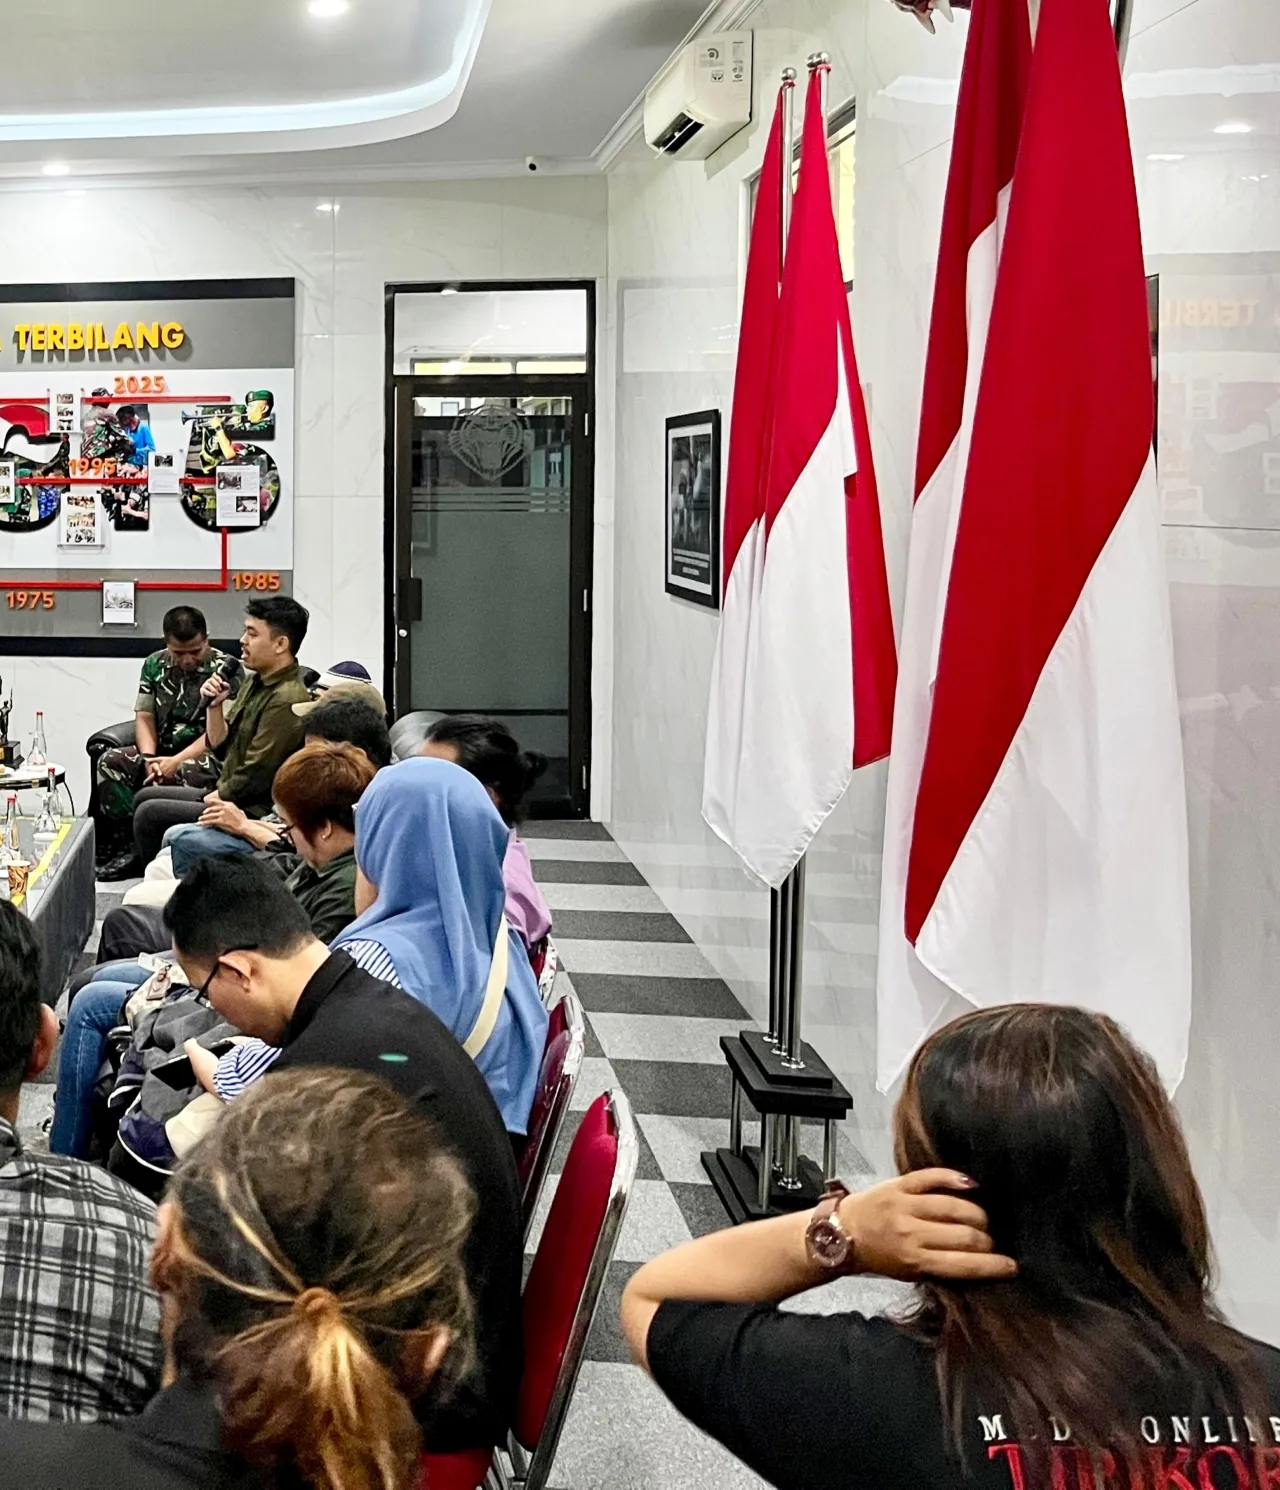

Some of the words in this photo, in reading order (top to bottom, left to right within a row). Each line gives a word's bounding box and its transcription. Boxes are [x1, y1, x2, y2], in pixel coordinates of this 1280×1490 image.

[15, 321, 185, 351] TERBILANG
[113, 375, 166, 395] 2025
[68, 456, 117, 476] 1995
[232, 571, 281, 591] 1985
[6, 590, 56, 610] 1975
